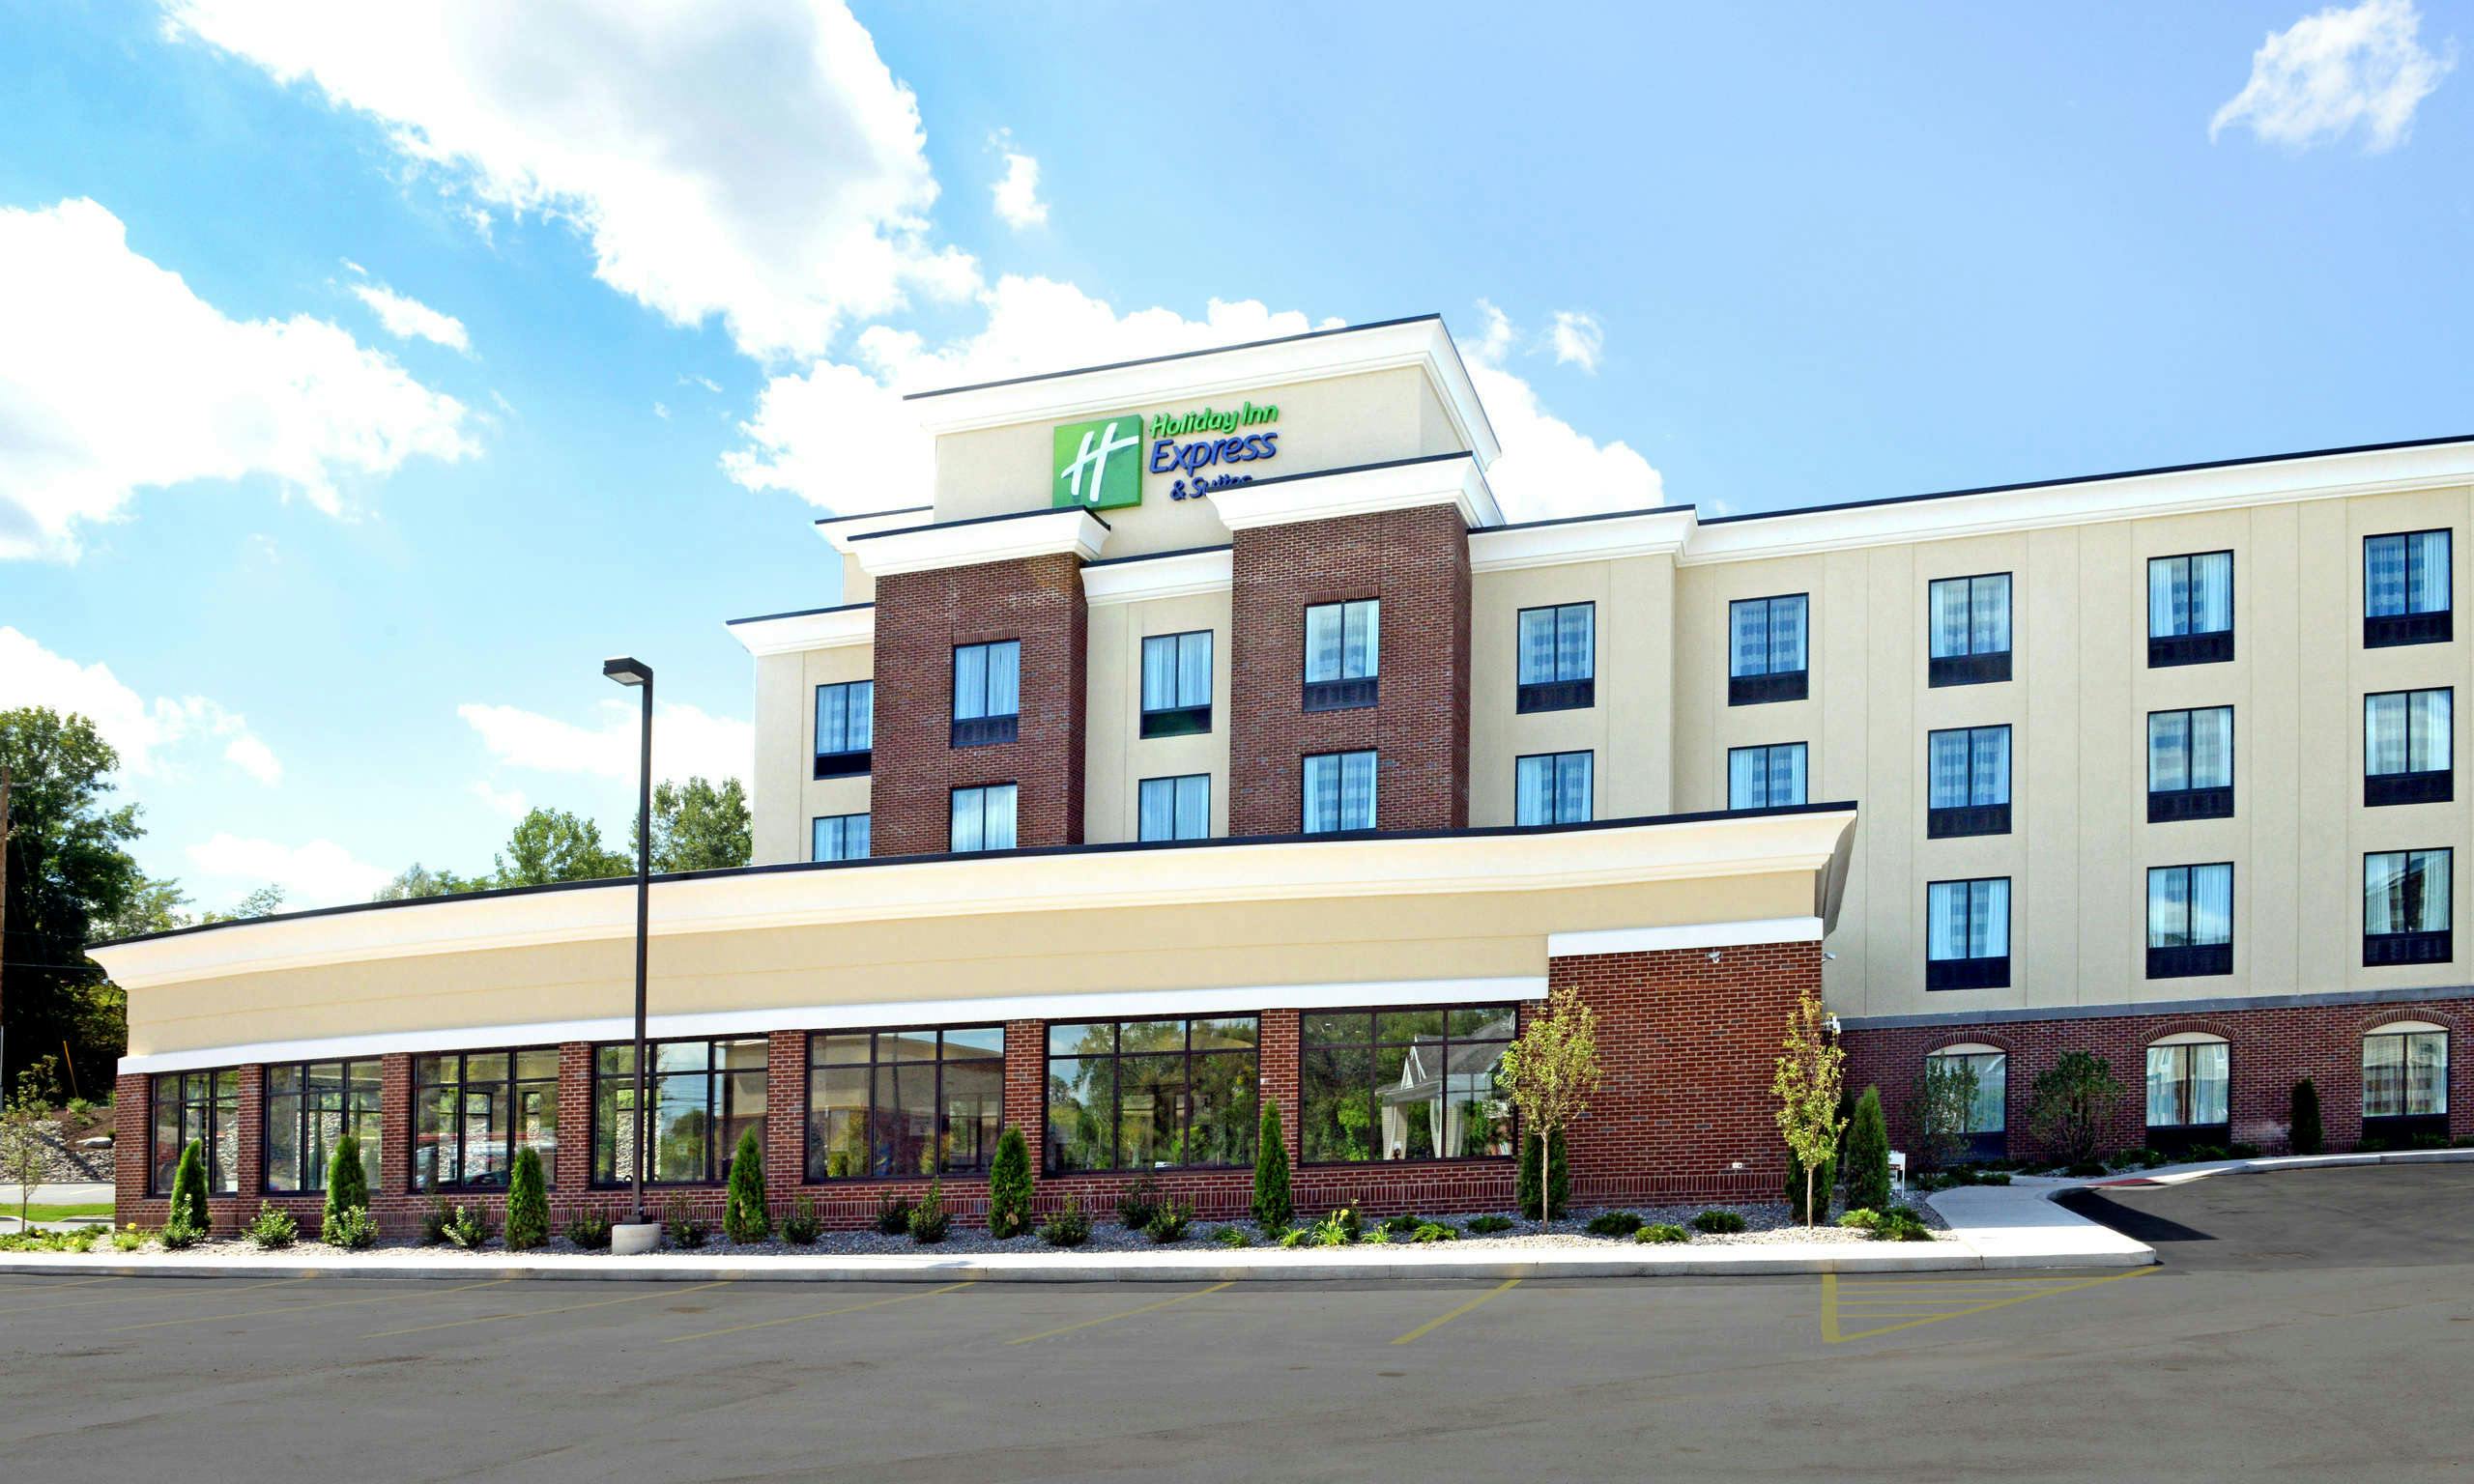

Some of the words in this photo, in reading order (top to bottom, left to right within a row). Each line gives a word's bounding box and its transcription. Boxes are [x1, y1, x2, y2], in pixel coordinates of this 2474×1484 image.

[1150, 407, 1239, 439] Holiday
[1241, 401, 1280, 425] Inn
[1149, 432, 1279, 477] Express
[1170, 479, 1187, 500] &
